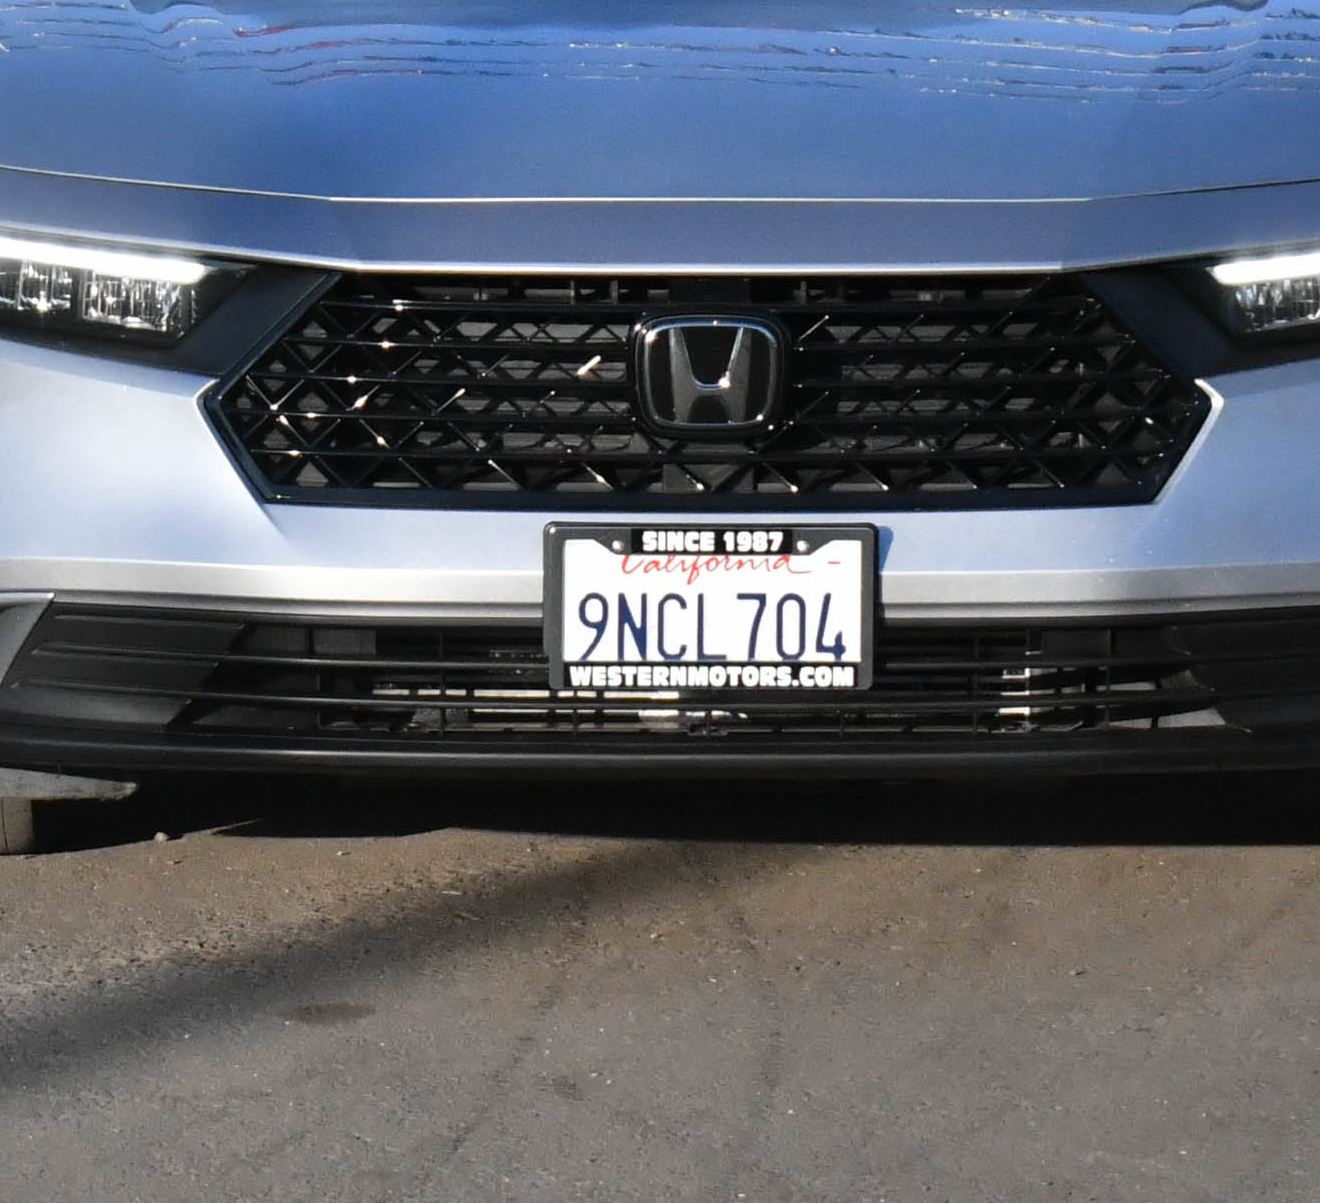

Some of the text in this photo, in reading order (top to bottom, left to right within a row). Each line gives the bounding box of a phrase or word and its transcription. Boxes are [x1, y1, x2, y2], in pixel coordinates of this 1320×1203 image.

[642, 530, 784, 553] SINCE 1987
[621, 554, 812, 586] California
[577, 592, 847, 661] 9NCL704
[569, 665, 855, 687] WESTERNMOTORS.COM
